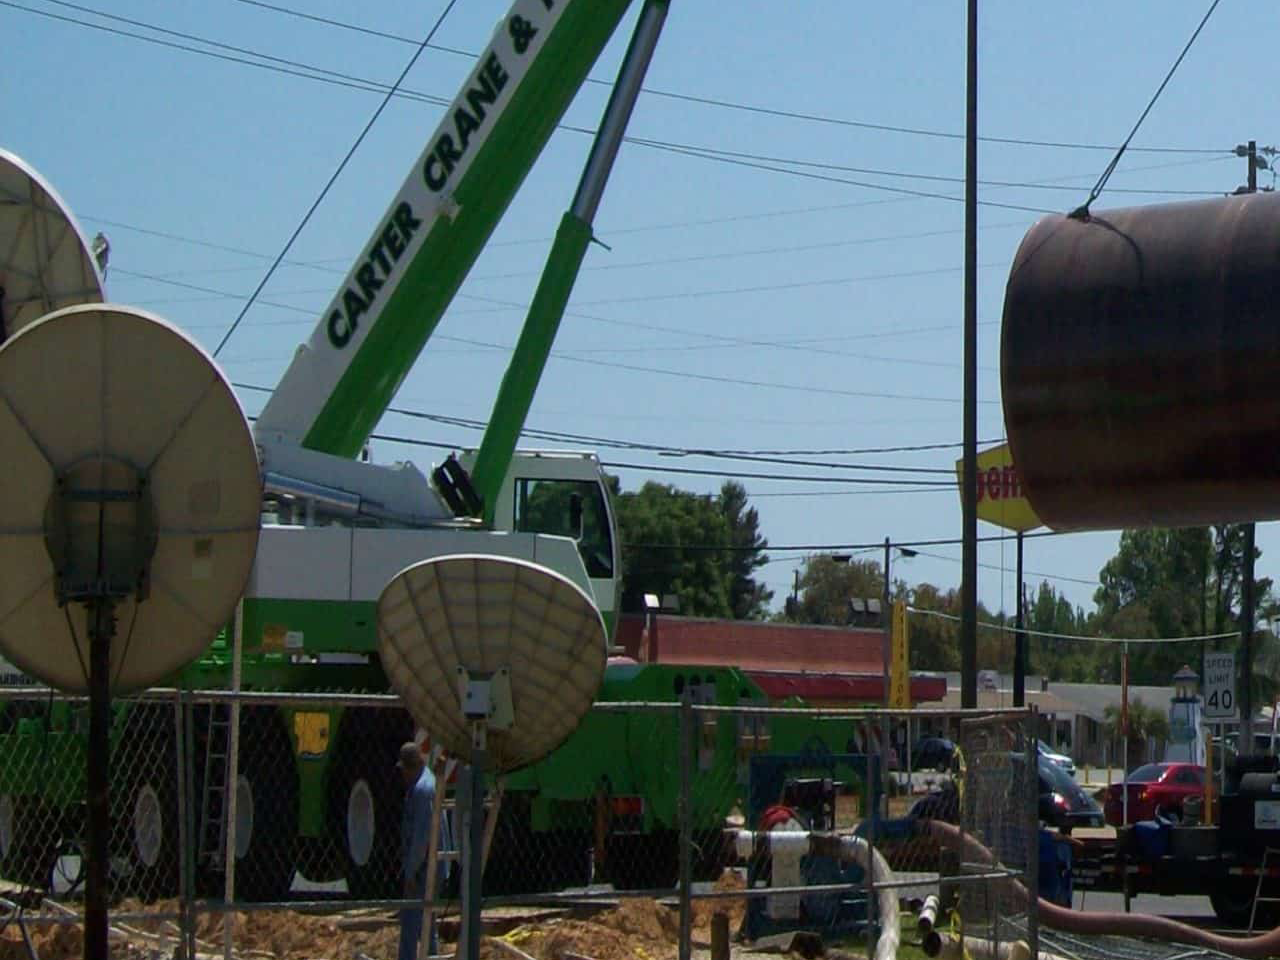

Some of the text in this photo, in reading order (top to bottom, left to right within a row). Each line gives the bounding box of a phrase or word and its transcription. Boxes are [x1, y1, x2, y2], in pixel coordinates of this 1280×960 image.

[326, 200, 425, 350] CARTER
[423, 50, 509, 193] CRANE
[508, 13, 540, 55] &
[1205, 658, 1233, 669] SPEED
[1208, 674, 1230, 686] LIMIT
[1207, 690, 1232, 710] 40
